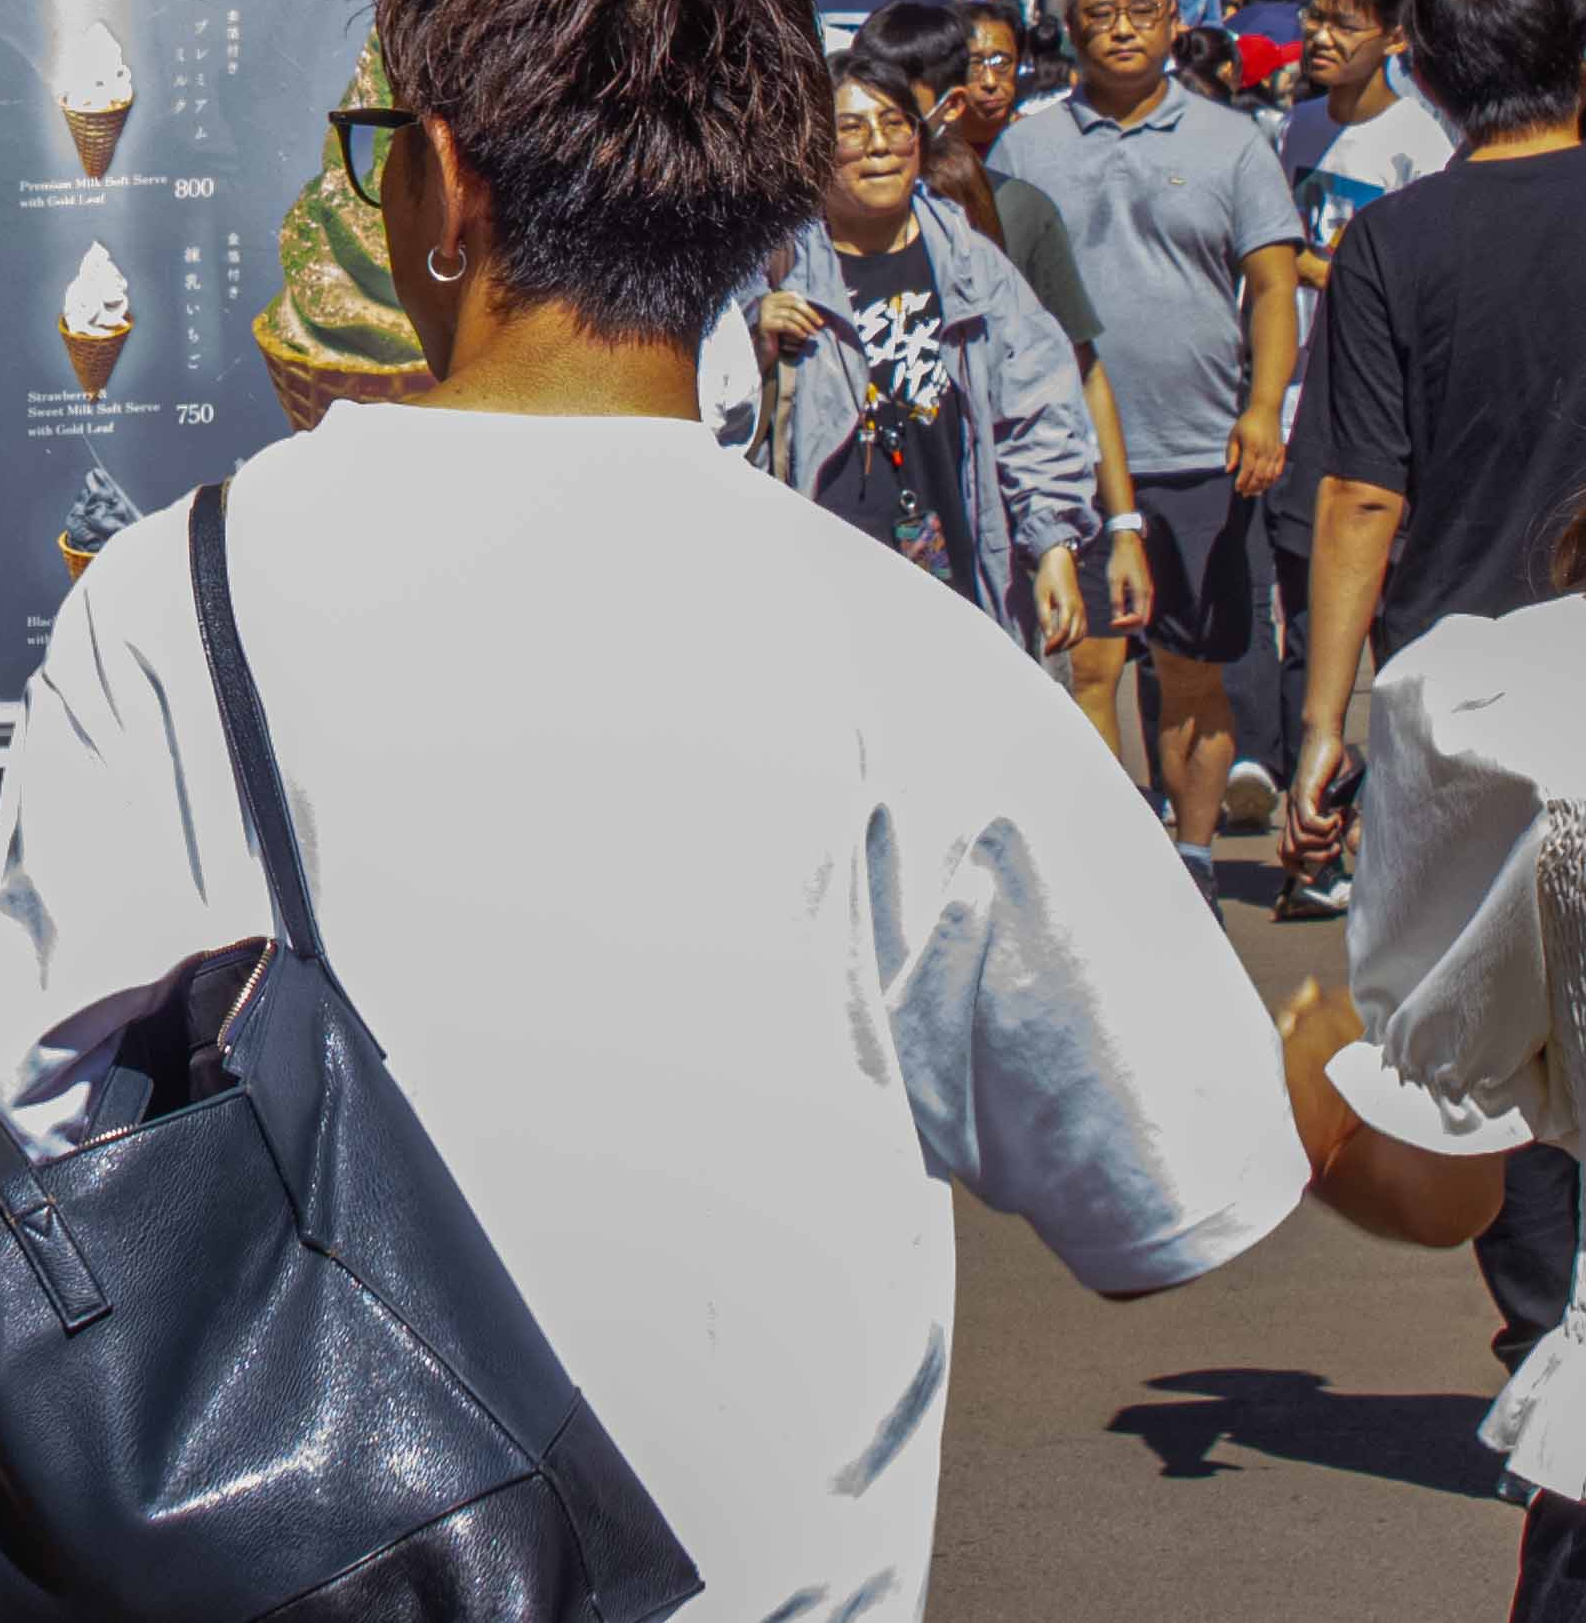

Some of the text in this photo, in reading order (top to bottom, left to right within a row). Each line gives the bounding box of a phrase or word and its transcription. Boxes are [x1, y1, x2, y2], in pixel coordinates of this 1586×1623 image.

[173, 48, 187, 113] ミルク
[195, 19, 210, 140] プレミアム
[19, 175, 168, 193] Premium Milk Soft Serve
[173, 177, 215, 199] 800
[19, 193, 106, 208] with Gold Leaf
[184, 246, 202, 370] 練乳いちご
[26, 390, 95, 405] Strawberry
[27, 401, 161, 418] Sweet Milk Soft Serve
[175, 404, 215, 425] 750
[27, 421, 115, 437] with Gold Leaf
